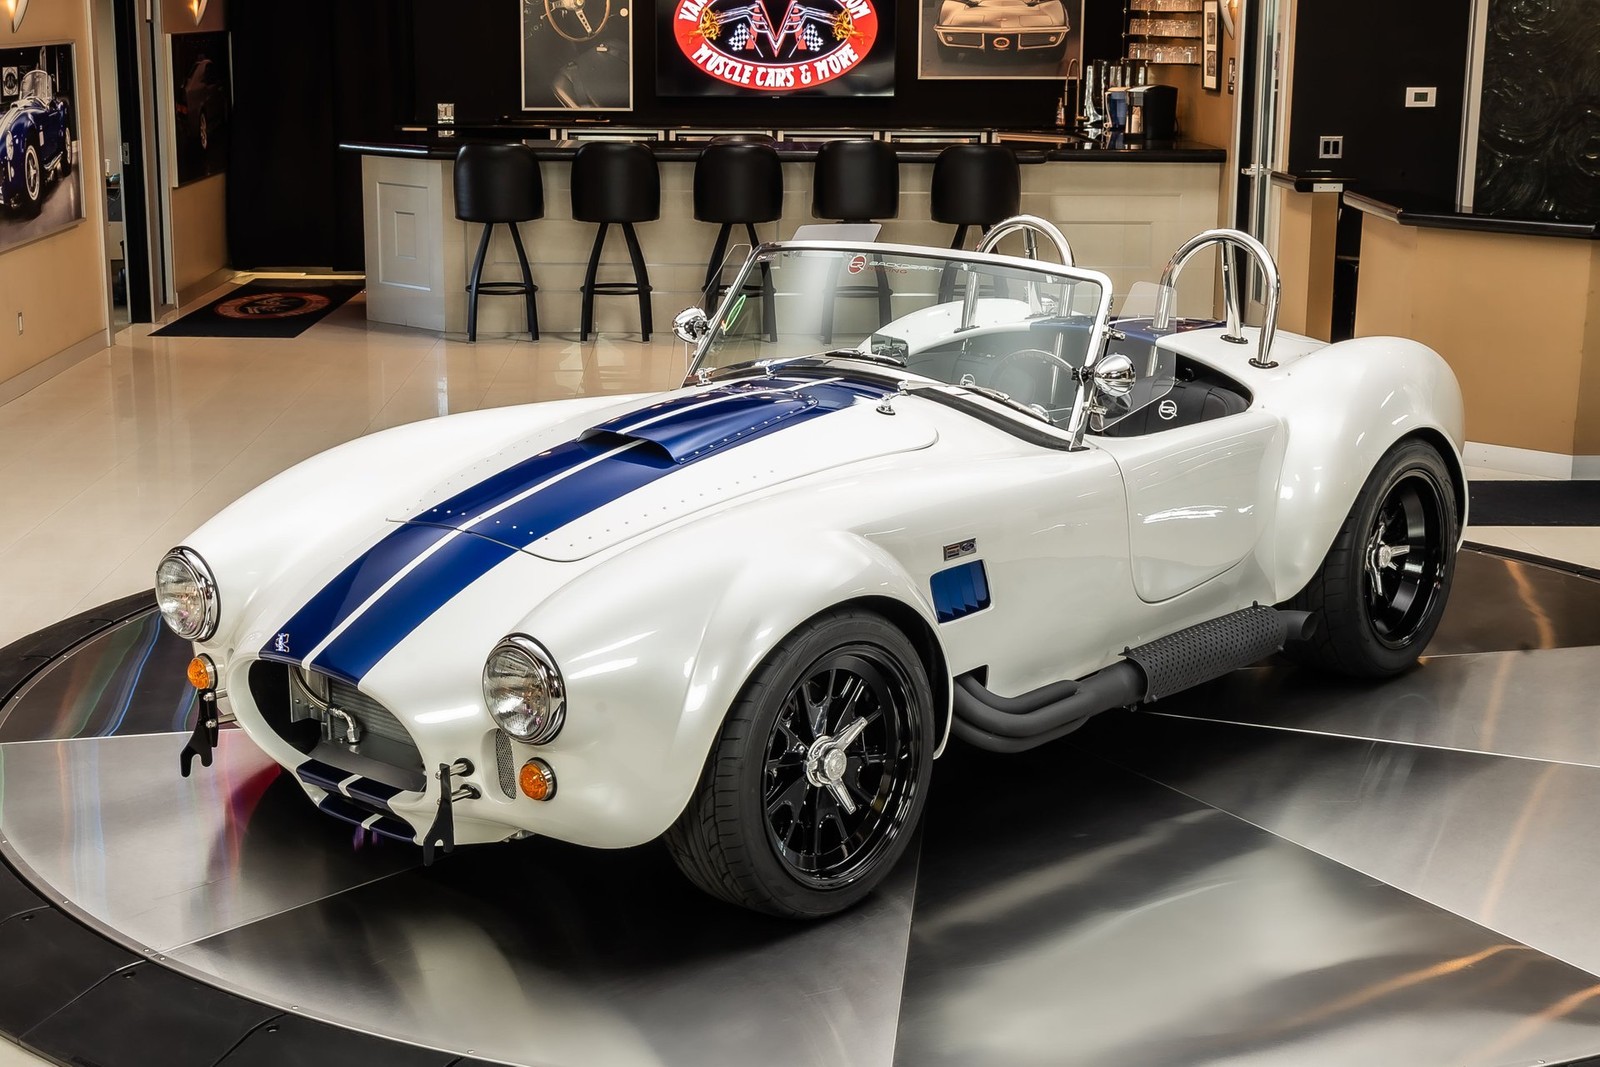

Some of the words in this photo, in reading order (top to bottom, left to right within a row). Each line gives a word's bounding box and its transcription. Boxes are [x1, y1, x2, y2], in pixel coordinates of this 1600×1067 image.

[692, 43, 752, 86] MUSCLE
[755, 66, 795, 88] CARS
[800, 66, 812, 85] &
[814, 43, 859, 81] MORE
[869, 260, 944, 273] BACKDRAFT
